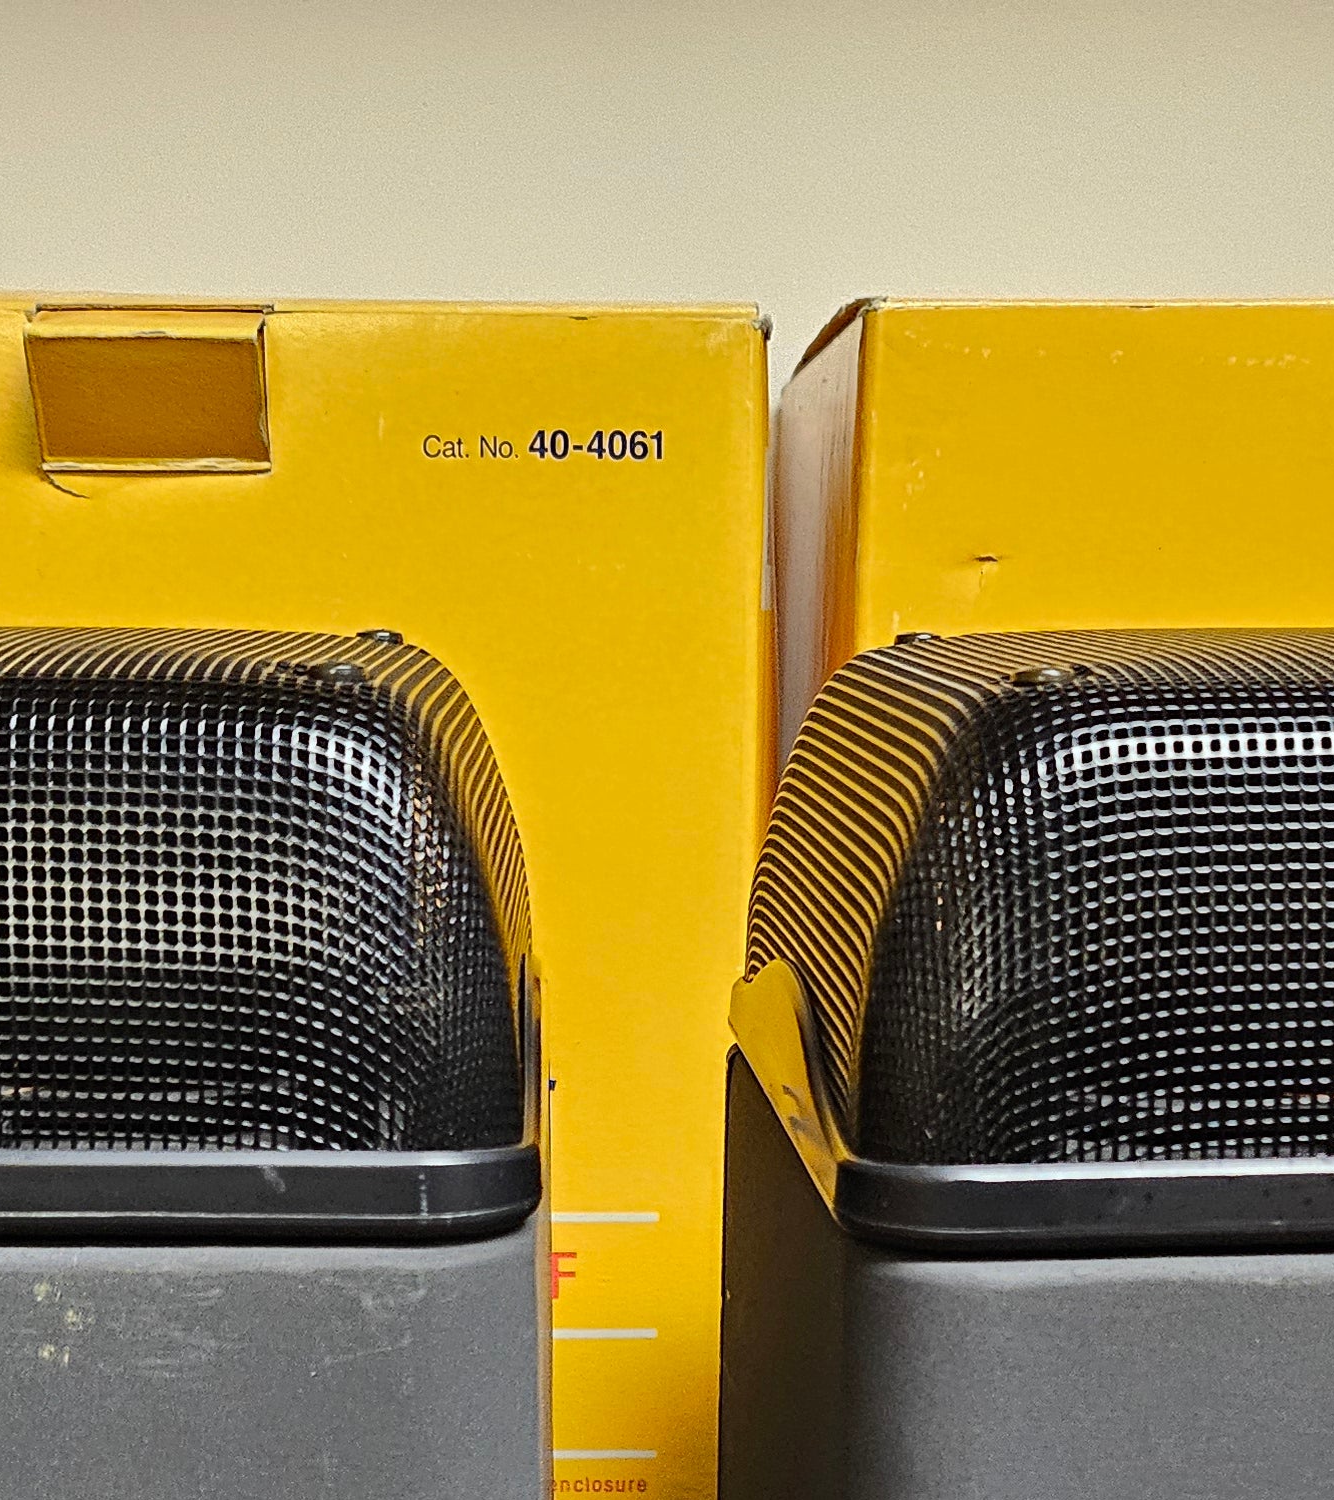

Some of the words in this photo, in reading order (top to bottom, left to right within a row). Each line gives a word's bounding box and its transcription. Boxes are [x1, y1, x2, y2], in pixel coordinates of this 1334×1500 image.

[423, 435, 469, 458] Cat.
[481, 435, 518, 458] No.
[529, 430, 662, 460] 40-4061
